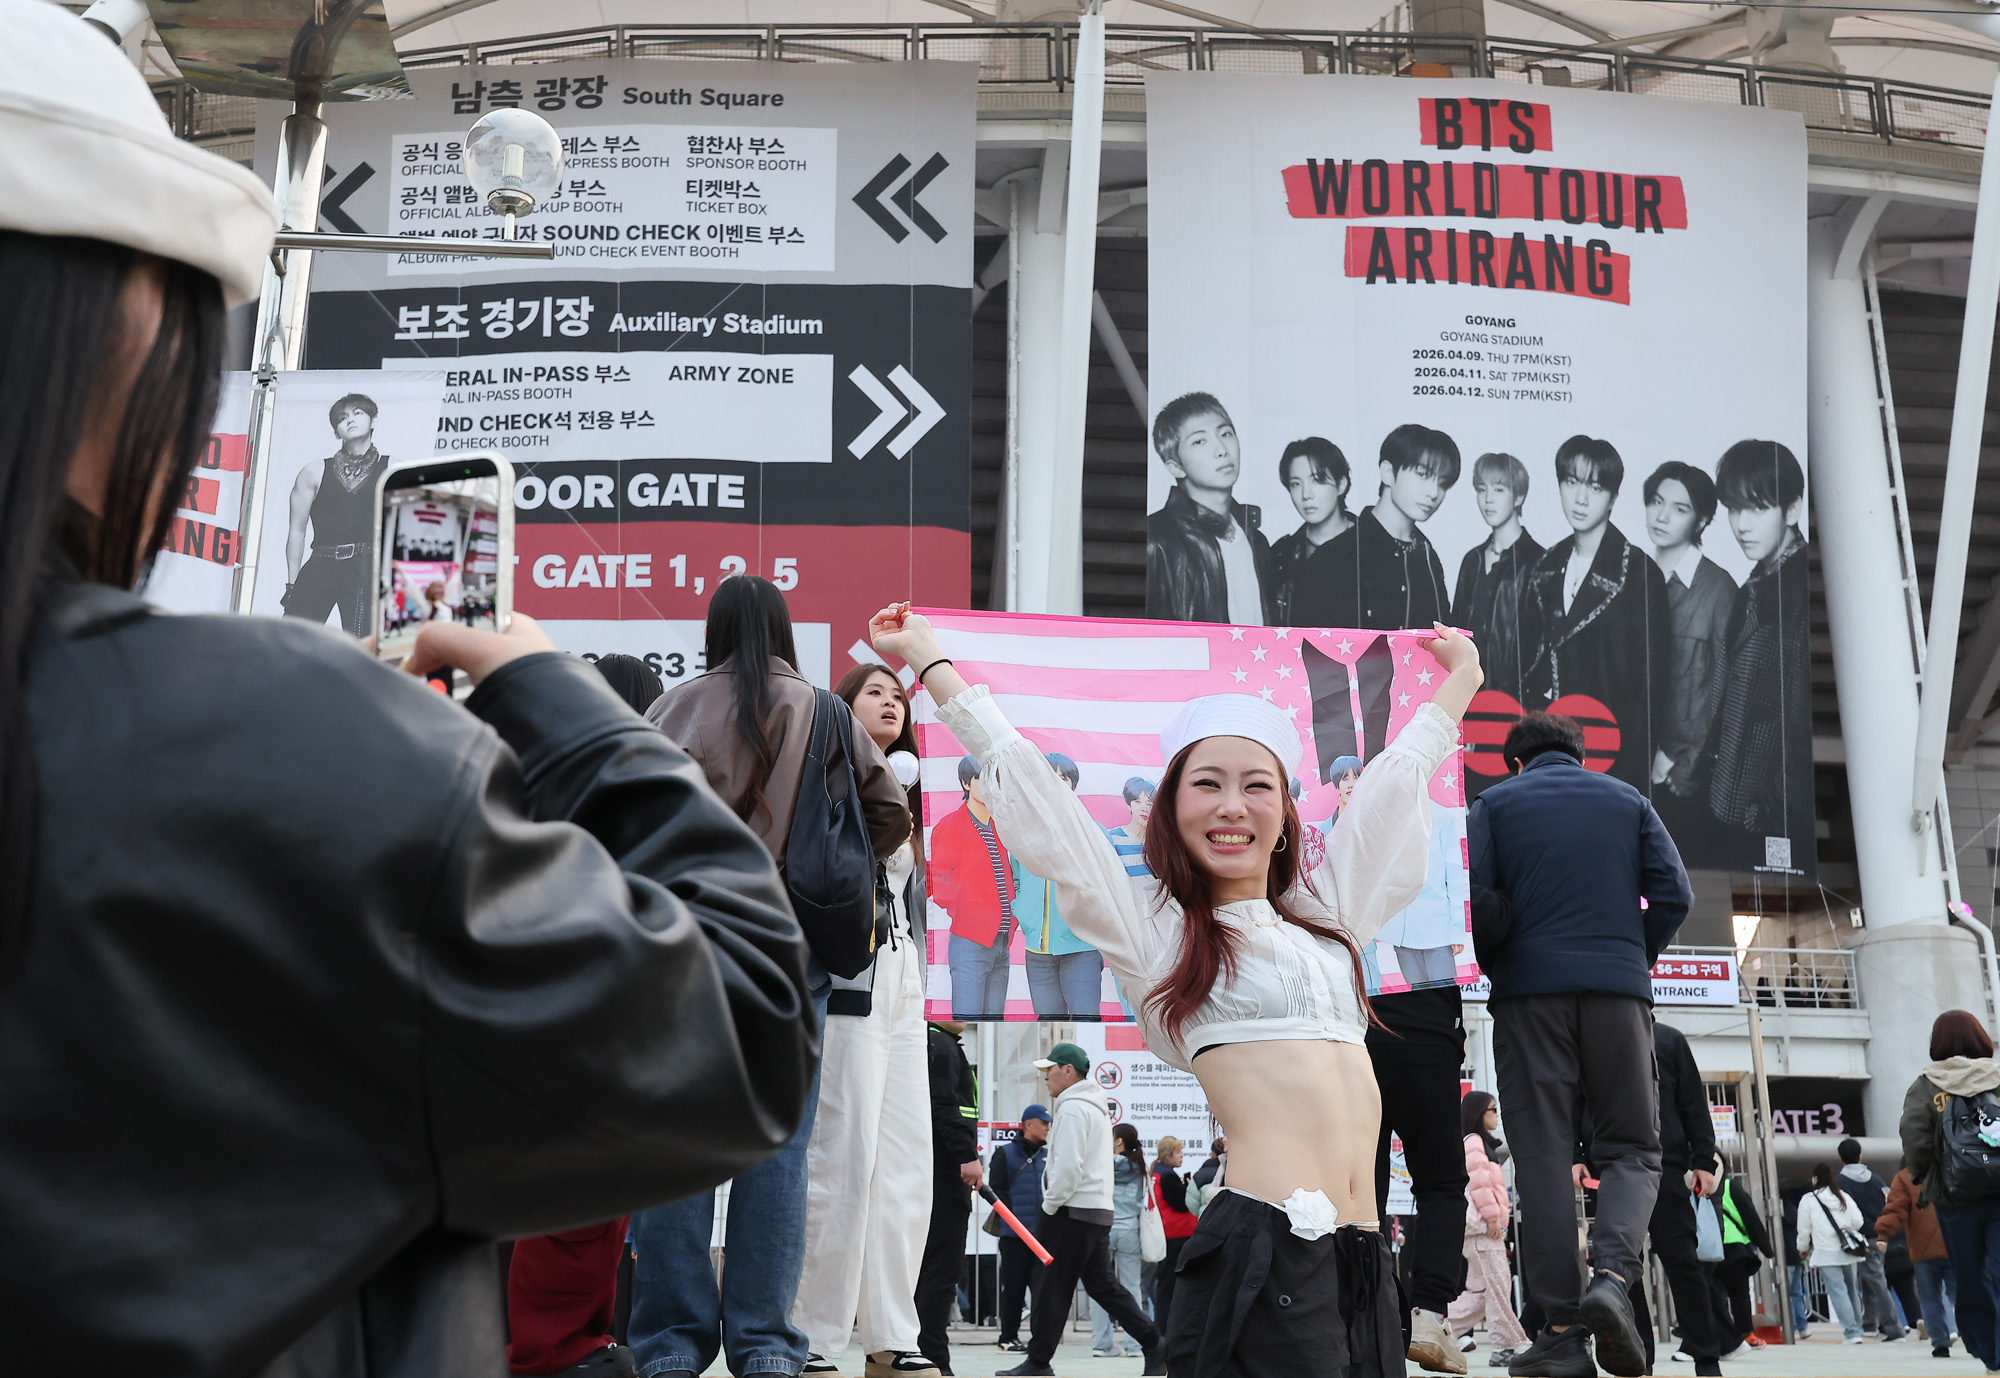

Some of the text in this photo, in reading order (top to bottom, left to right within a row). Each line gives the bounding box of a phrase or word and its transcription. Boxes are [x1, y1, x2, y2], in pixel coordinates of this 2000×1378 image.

[452, 75, 784, 114] 남측 광장 South Square
[1435, 98, 1536, 153] BTS
[402, 143, 438, 163] 공식
[603, 136, 640, 154] 부스
[687, 136, 785, 155] 협찬사 부스
[402, 157, 669, 176] OFFICIAL XPRESS BOOTH
[686, 157, 807, 171] SPONSOR BOOTH
[400, 186, 437, 205] 공식
[569, 180, 606, 198] 부스
[686, 180, 760, 199] 티켓박스
[1306, 158, 1664, 234] WORLD TOUR
[400, 207, 462, 220] OFFICIAL
[466, 206, 494, 218] ALB
[574, 202, 622, 213] BOOTH
[686, 202, 767, 215] TICKET BOX
[543, 225, 619, 241] SOUND
[627, 225, 701, 241] CHECK
[708, 224, 762, 244] 이벤트
[768, 226, 805, 245] 부스
[554, 245, 586, 257] UND
[590, 246, 637, 258] CHECK
[641, 245, 686, 257] EVENT
[690, 246, 739, 258] BOOTH
[1366, 227, 1613, 296] ARIRANG
[395, 296, 823, 340] 보조 경기장 Auxiliary Stadium
[1465, 315, 1516, 328] GOYANG
[1440, 331, 1543, 347] GOYANG STADIUM
[1412, 349, 1572, 368] 2026.04.09. THU 7PM(KST)
[446, 365, 631, 387] ERAL IN-PASS 부스
[668, 365, 794, 384] ARMY ZONE
[1414, 367, 1571, 385] 2026.04.11. SAT 7PM(KST)
[468, 389, 520, 404] IN-PASS
[524, 387, 572, 400] BOOTH
[1412, 385, 1573, 403] 2026.04.12. SUN 7PM(KST)
[480, 411, 571, 432] CHECK석
[578, 411, 614, 430] 전용
[619, 410, 655, 430] 부스
[451, 436, 498, 450] CHECK
[502, 434, 549, 448] BOOTH
[513, 473, 745, 510] OOR GATE
[532, 554, 652, 589] GATE
[669, 553, 705, 595] 1,
[772, 557, 799, 592] 5
[1701, 963, 1722, 978] 구역
[1653, 986, 1708, 997] NTRANCE
[1131, 1103, 1153, 1112] 타인의
[1773, 1103, 1844, 1134] ATE3
